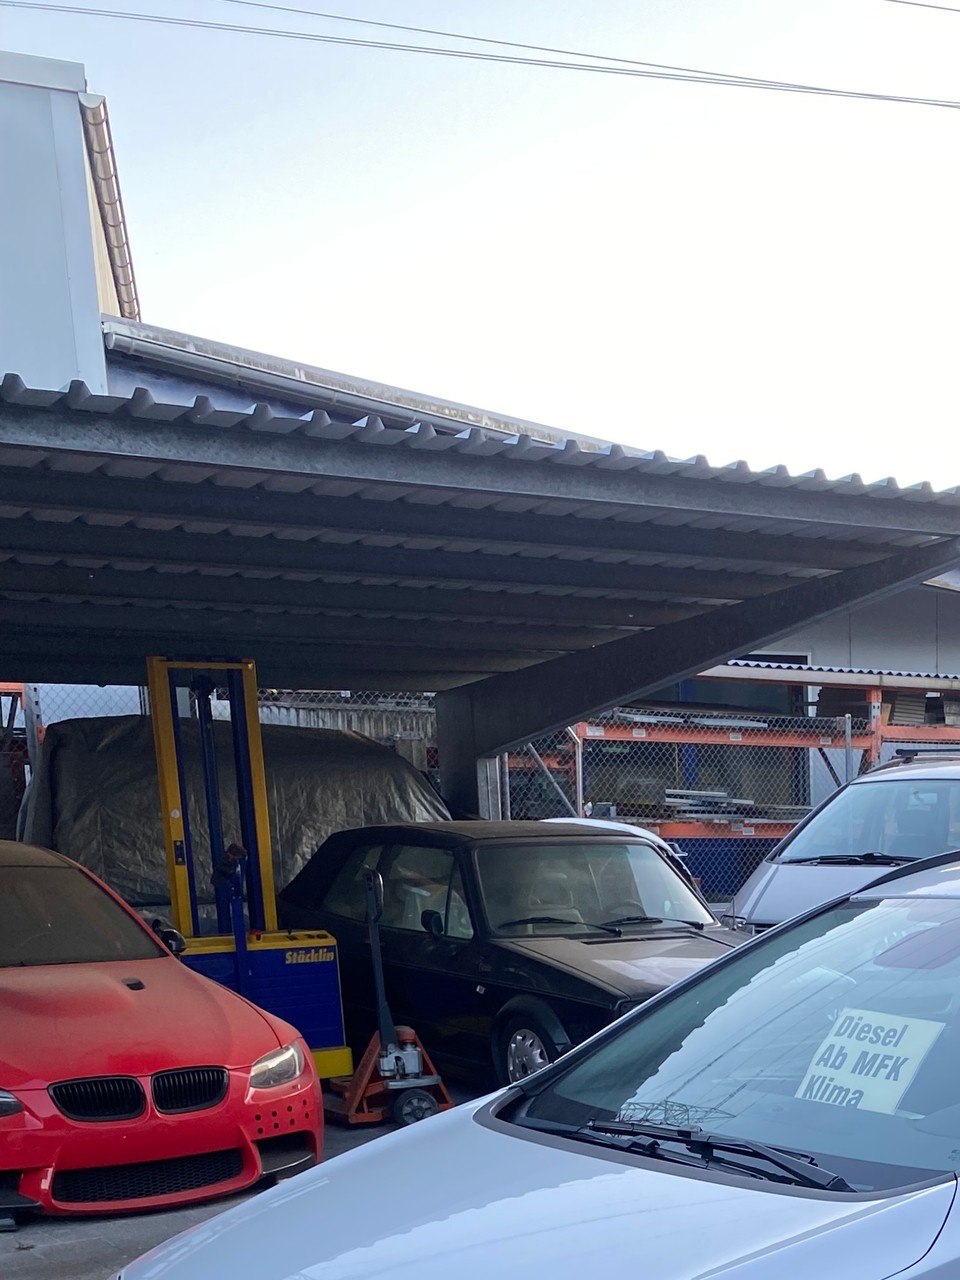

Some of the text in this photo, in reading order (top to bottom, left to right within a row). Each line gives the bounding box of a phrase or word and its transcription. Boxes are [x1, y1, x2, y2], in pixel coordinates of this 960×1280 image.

[834, 1015, 909, 1048] Diesel
[815, 1044, 910, 1082] Ab MFK
[801, 1074, 865, 1107] Klima
